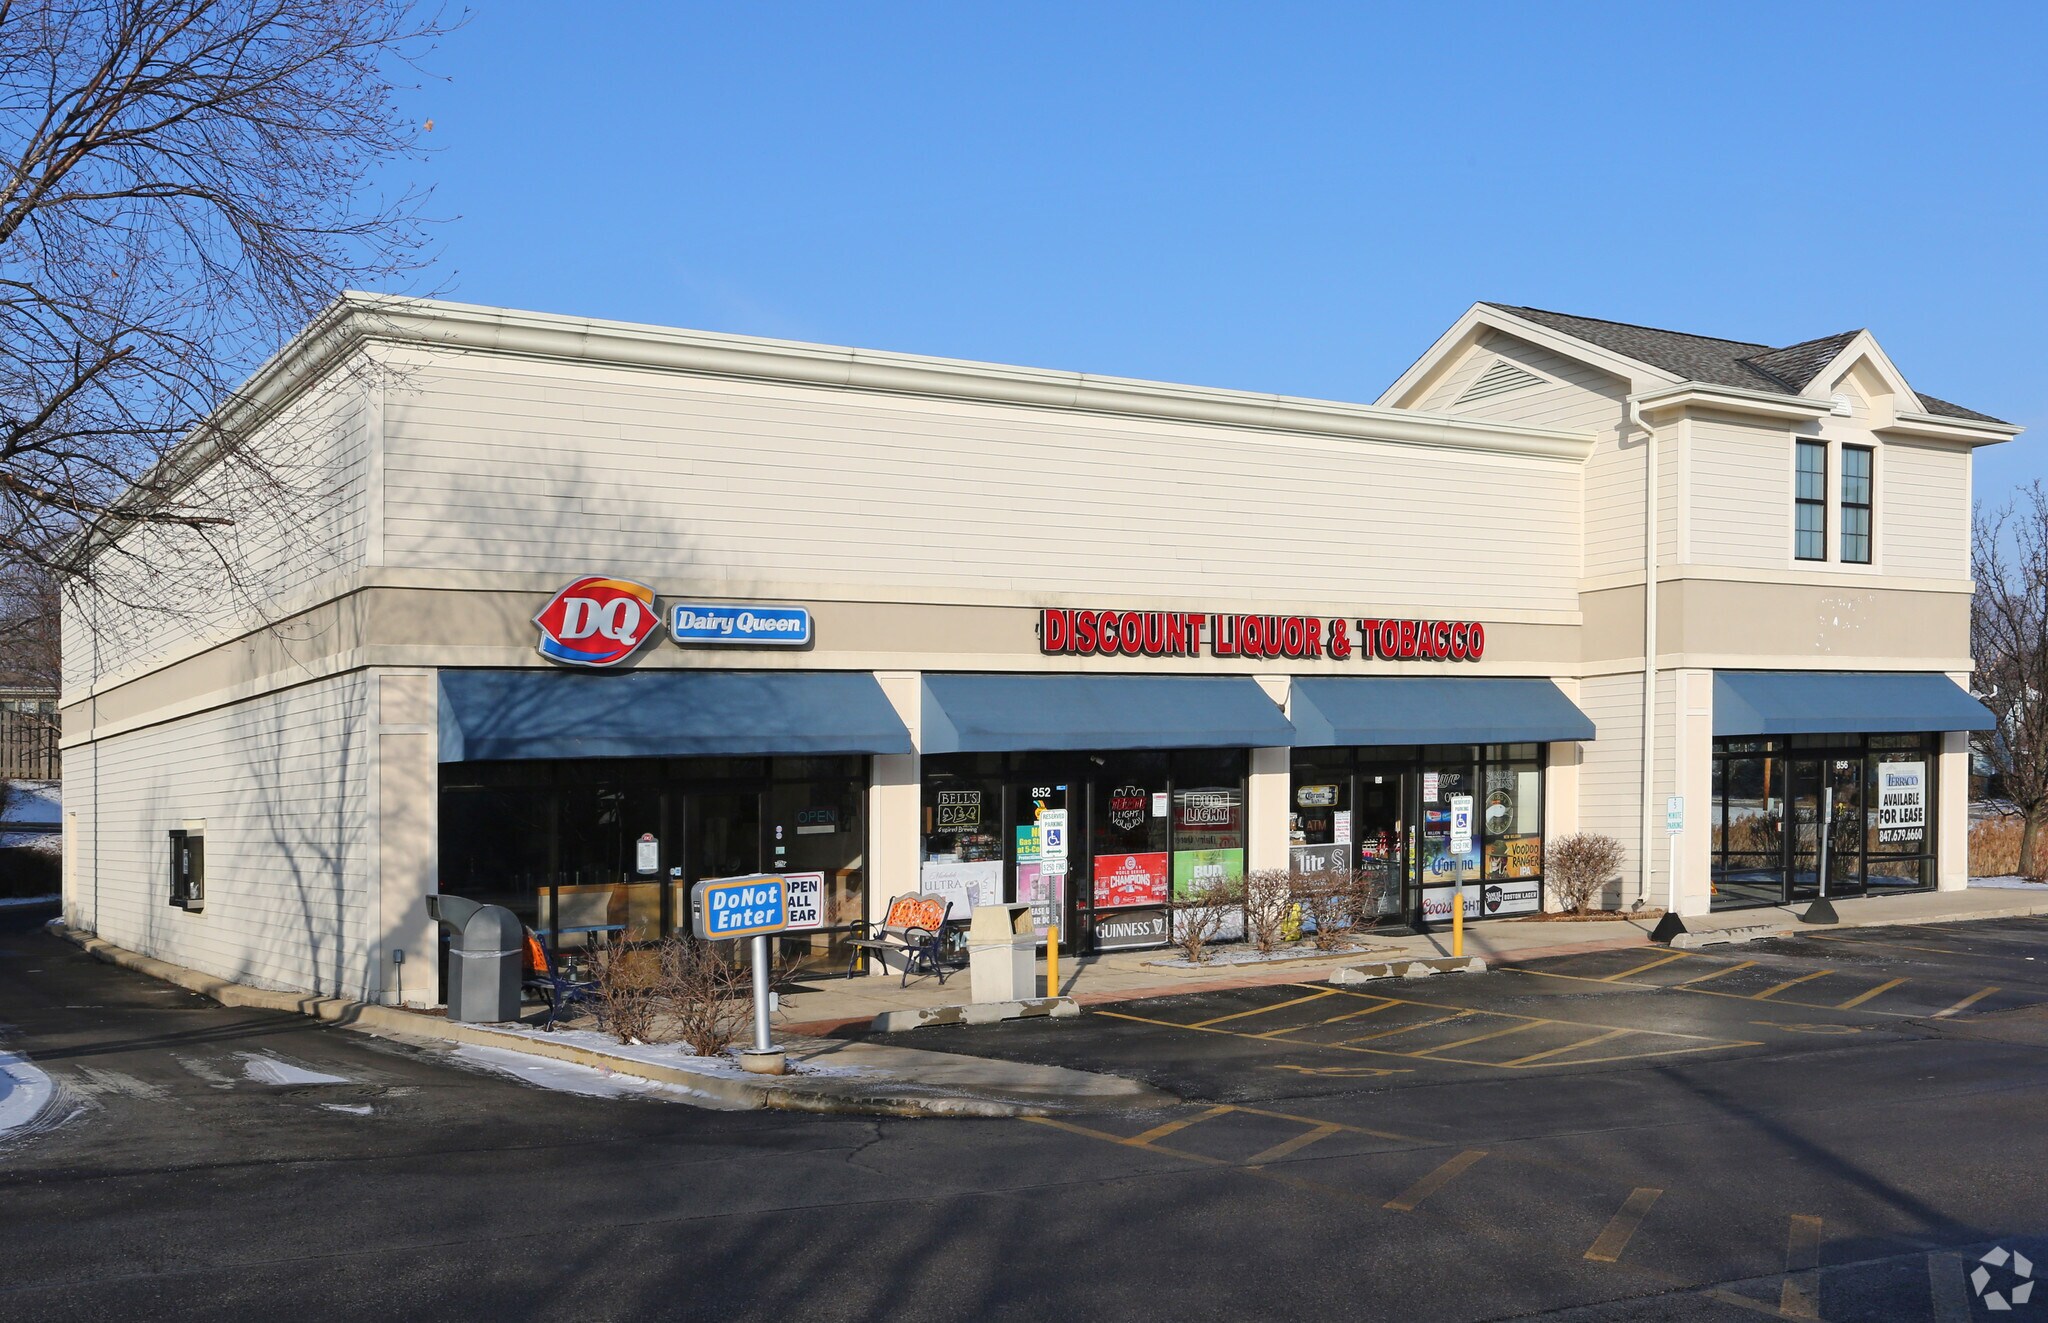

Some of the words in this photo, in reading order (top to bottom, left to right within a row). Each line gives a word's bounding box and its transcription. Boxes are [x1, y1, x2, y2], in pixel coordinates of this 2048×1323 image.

[559, 597, 641, 645] DQ
[677, 611, 734, 634] Dairy
[736, 612, 801, 632] Queen
[1043, 608, 1206, 656] DISCOUNT
[1211, 613, 1323, 660] LIQUOR
[1331, 618, 1352, 660] &
[1361, 618, 1486, 661] TOBACCO
[1836, 761, 1848, 769] 856
[1886, 774, 1919, 787] TERRACO
[942, 793, 977, 803] BELL'S
[1032, 788, 1051, 797] 852
[1883, 792, 1919, 806] AVAILABLE
[1193, 794, 1221, 808] BUD
[797, 811, 835, 823] OPEN
[1187, 808, 1228, 821] LIGHT
[1880, 809, 1897, 824] FOR
[1900, 807, 1923, 823] LEASE
[1307, 820, 1327, 831] ATM
[1879, 828, 1923, 842] 847.679.6660
[1512, 843, 1539, 855] VOODOO
[1432, 856, 1474, 877] Corna
[1513, 855, 1539, 868] RANGER
[1194, 865, 1223, 878] BUD
[1521, 867, 1531, 875] IPA
[925, 879, 962, 891] ULTRA
[1110, 874, 1151, 888] CHAMPIONS
[787, 896, 811, 907] ALL
[1422, 898, 1452, 915] Coors
[717, 908, 775, 930] Enter
[1096, 921, 1150, 939] GUINNESS
